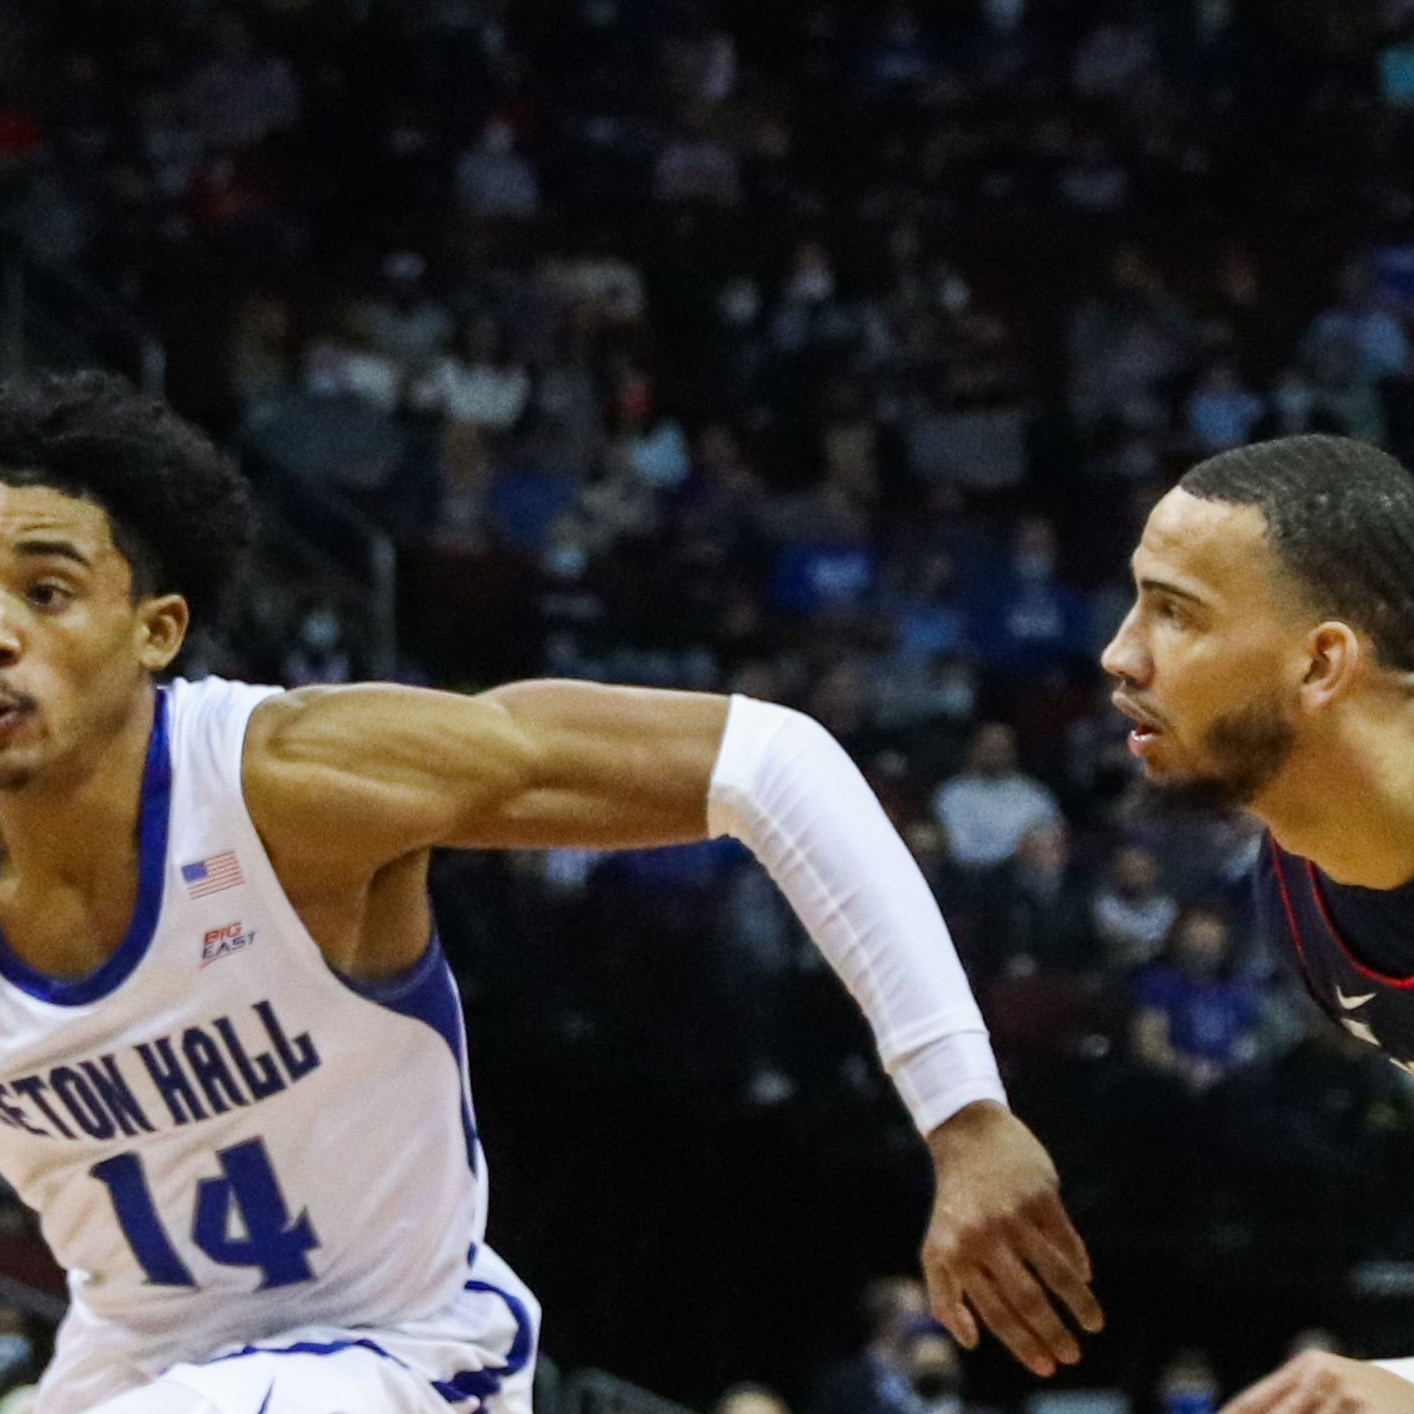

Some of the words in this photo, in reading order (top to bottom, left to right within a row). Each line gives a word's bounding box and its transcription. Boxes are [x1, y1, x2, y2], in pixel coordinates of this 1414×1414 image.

[202, 930, 258, 960] EAST
[203, 922, 242, 946] BIG
[134, 1000, 321, 1127] HALL
[89, 1135, 322, 1292] 14
